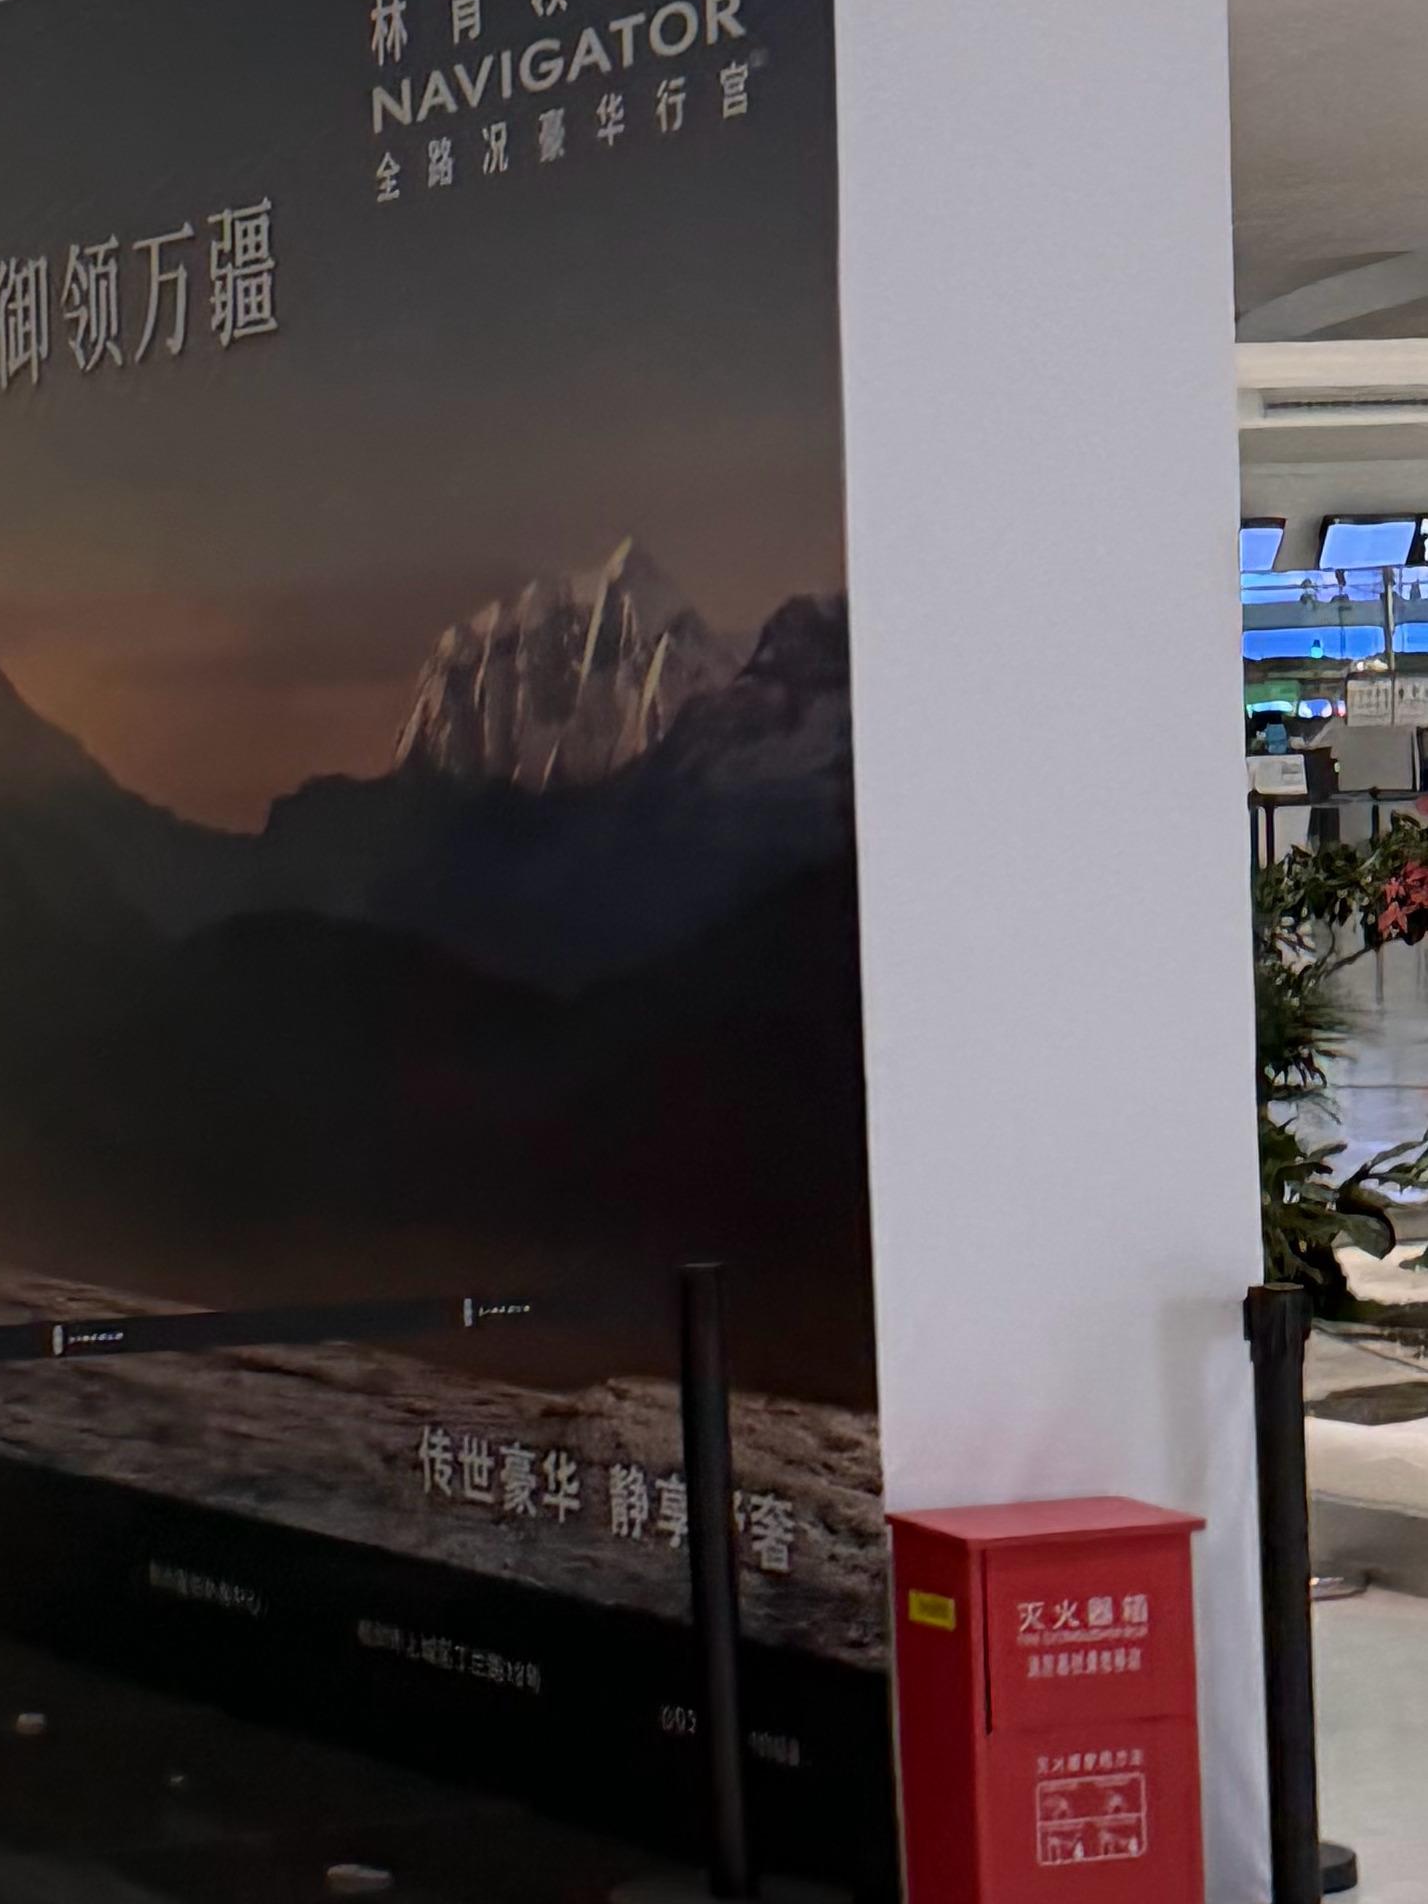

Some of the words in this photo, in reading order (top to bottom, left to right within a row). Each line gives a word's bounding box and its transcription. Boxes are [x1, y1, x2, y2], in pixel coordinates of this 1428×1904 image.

[375, 60, 749, 203] 全路况豪华行宫
[418, 1424, 582, 1524] 传世豪华
[608, 1462, 795, 1575] 静享奢
